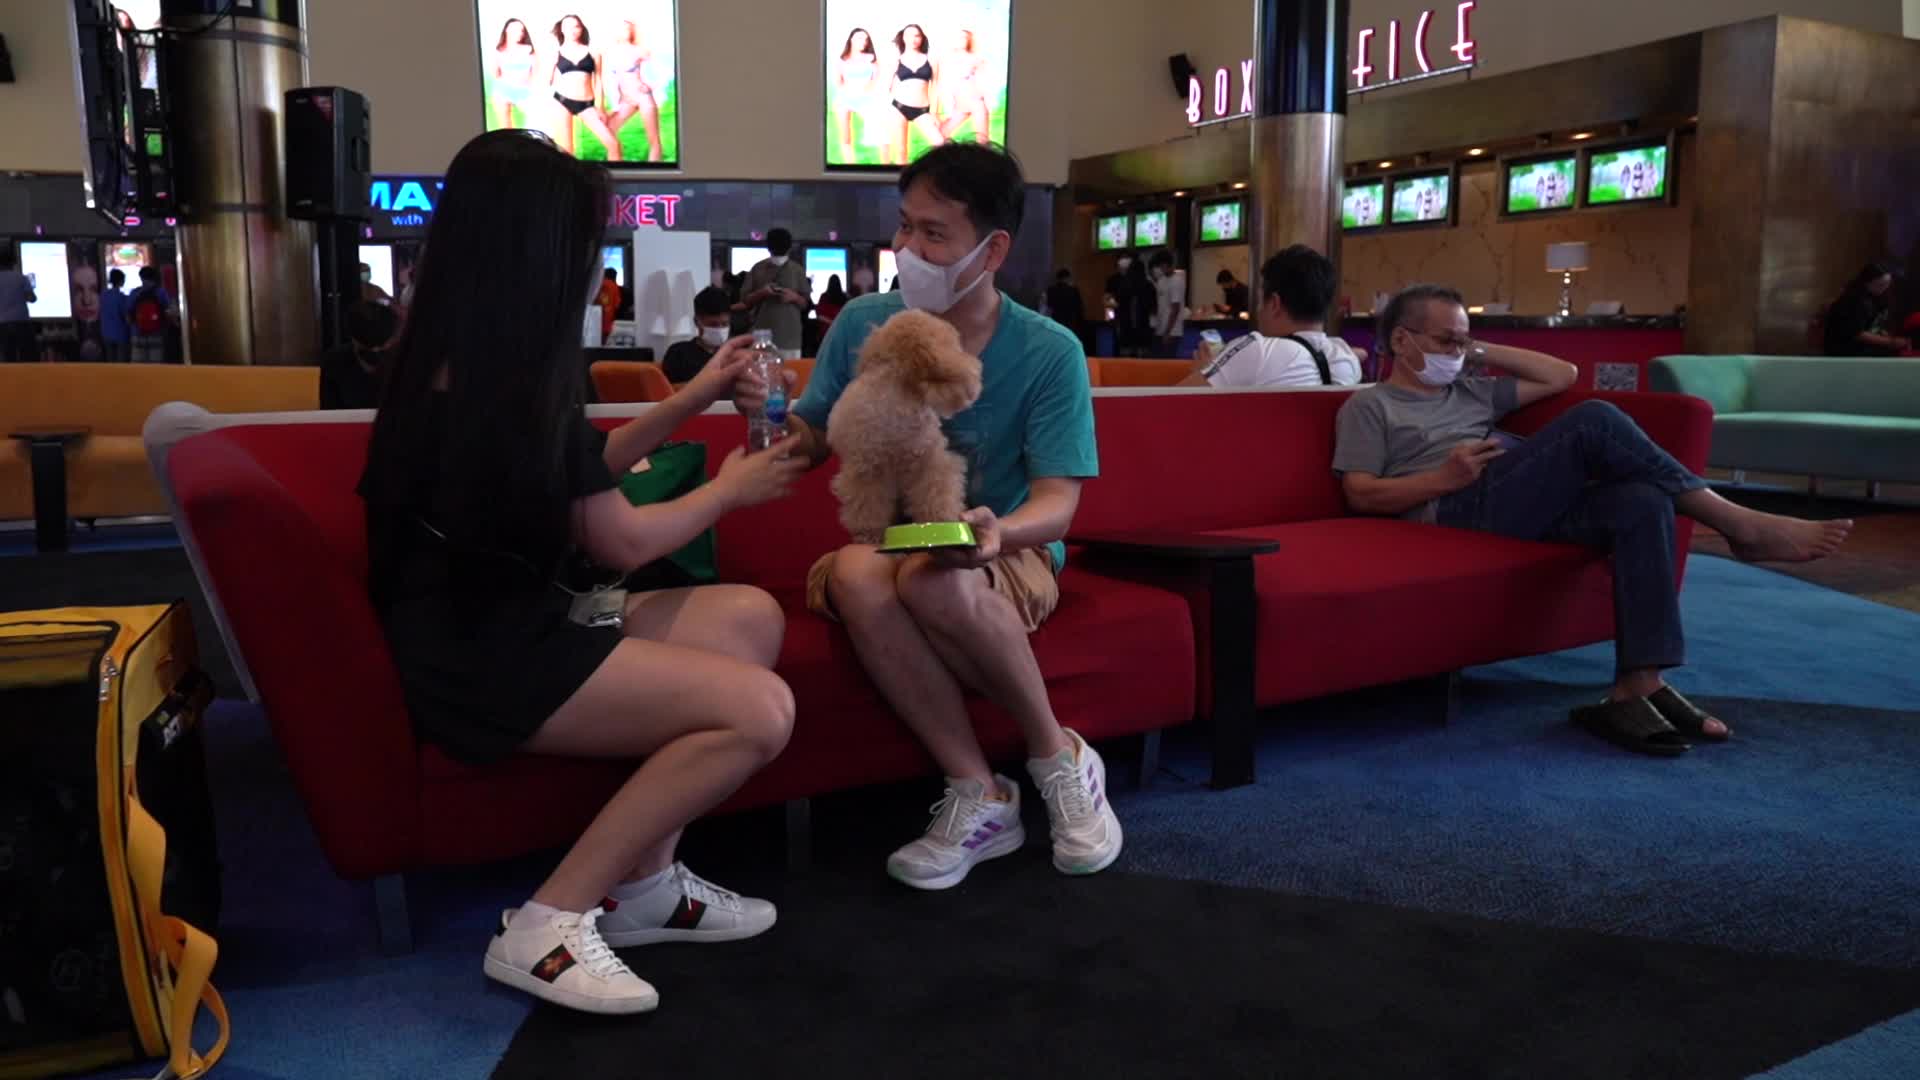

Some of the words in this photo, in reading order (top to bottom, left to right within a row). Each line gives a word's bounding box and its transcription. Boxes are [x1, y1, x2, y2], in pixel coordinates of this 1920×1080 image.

[1185, 60, 1254, 124] BOX
[1352, 1, 1476, 87] FICE
[370, 181, 444, 211] MA
[613, 193, 682, 227] KET
[391, 213, 424, 226] with
